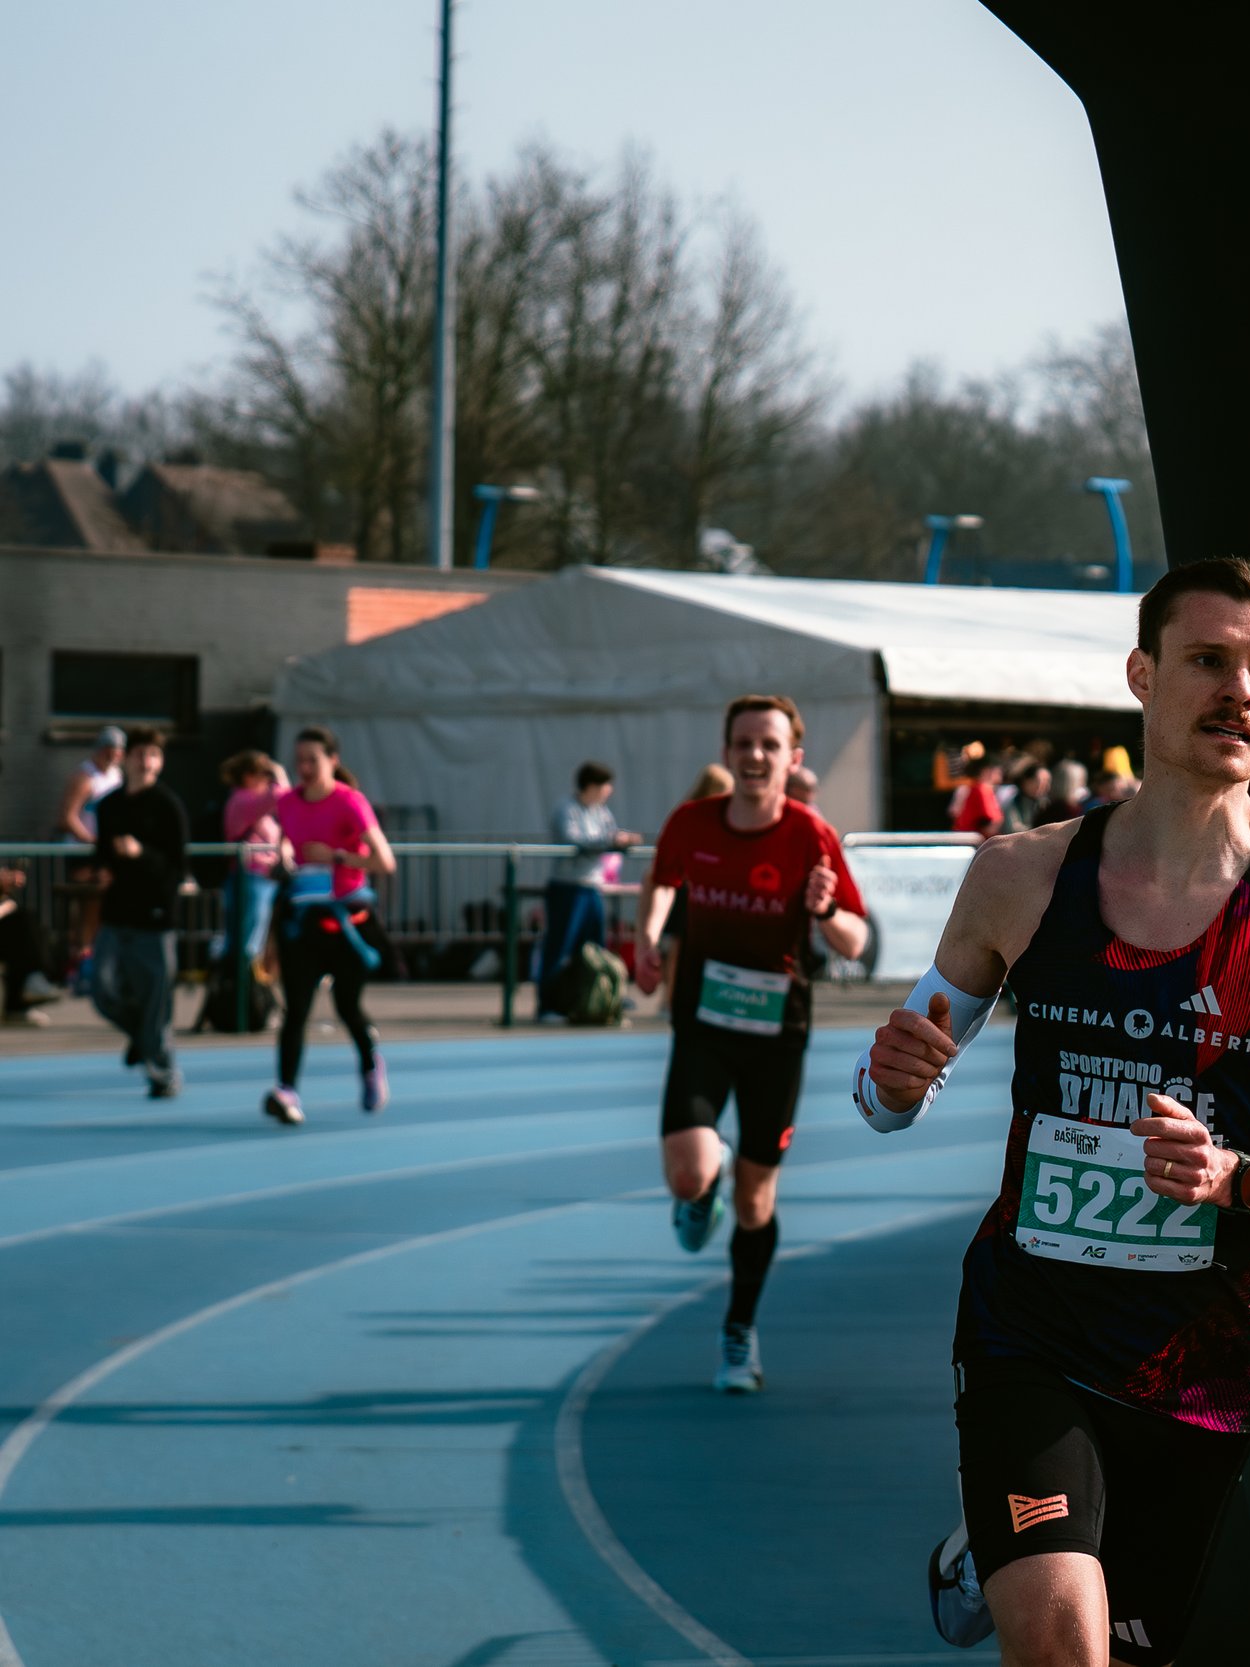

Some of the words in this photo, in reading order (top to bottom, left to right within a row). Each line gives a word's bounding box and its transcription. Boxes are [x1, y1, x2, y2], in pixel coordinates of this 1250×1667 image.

[1028, 1002, 1116, 1029] CINEMA
[1059, 1050, 1163, 1085] SPORTPODO
[1033, 1161, 1202, 1239] 5222
[1081, 1245, 1107, 1259] AG
